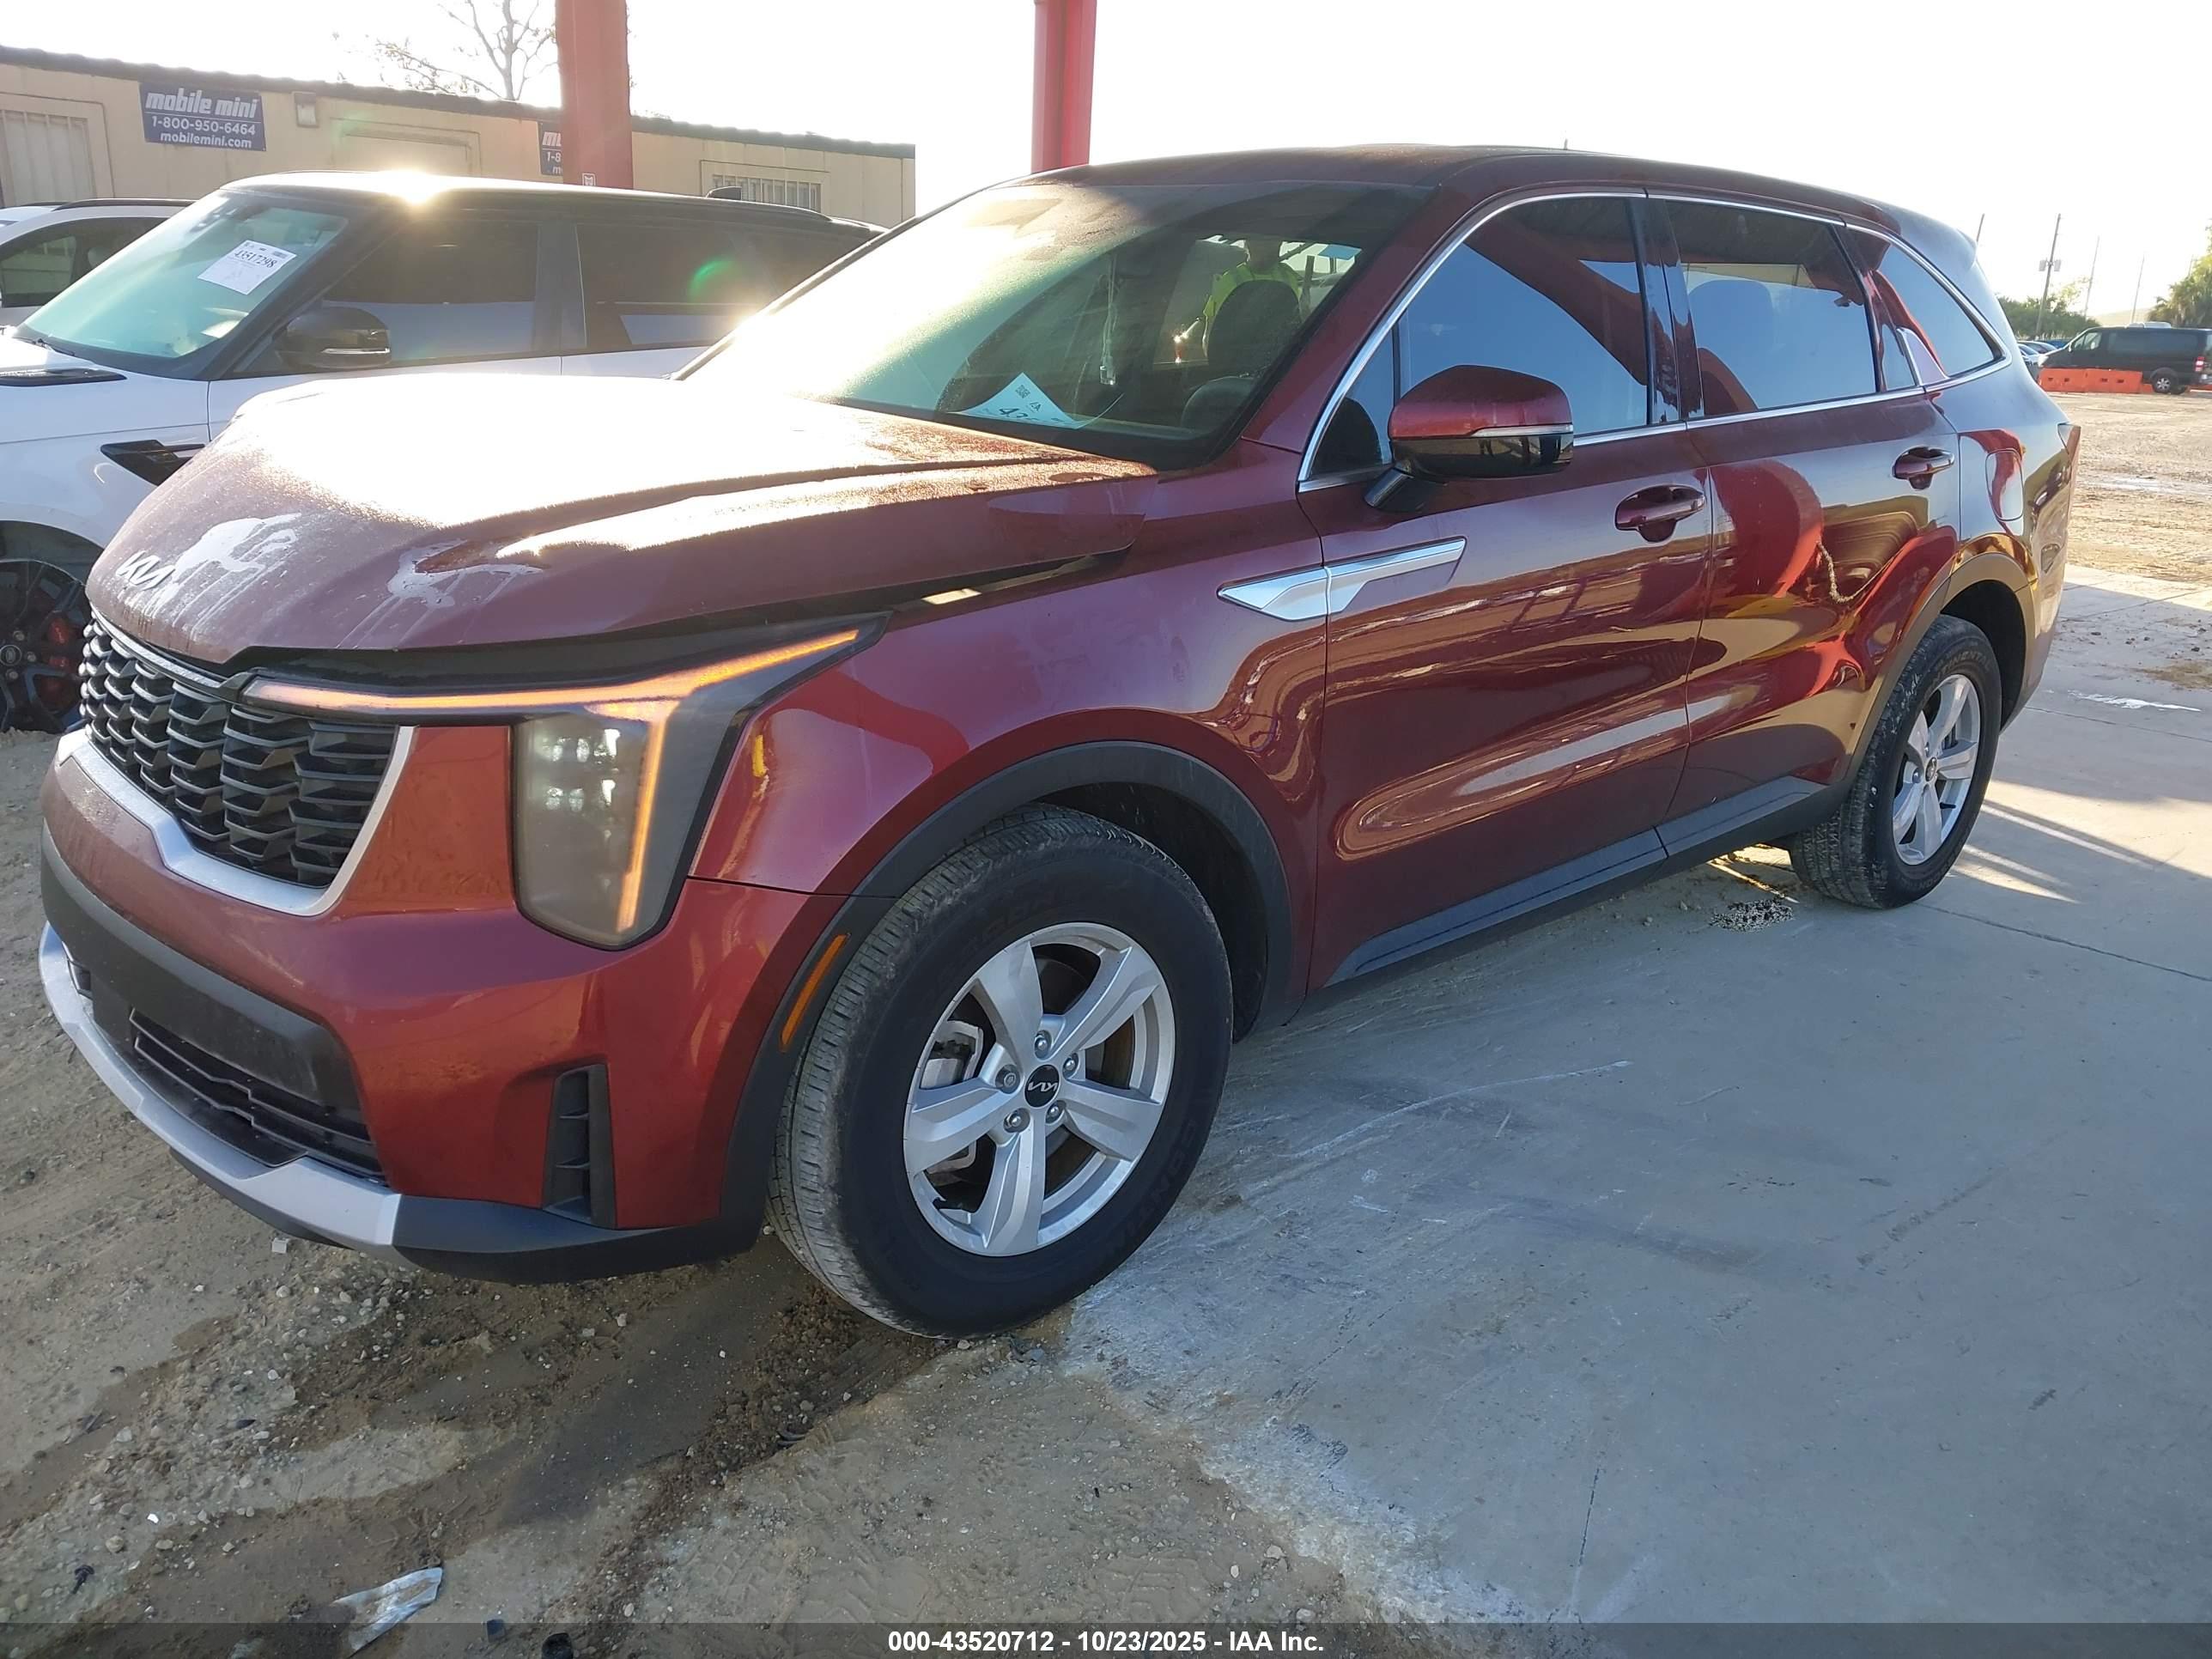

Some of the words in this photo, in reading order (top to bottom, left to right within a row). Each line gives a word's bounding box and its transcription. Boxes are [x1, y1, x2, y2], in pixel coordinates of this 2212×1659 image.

[145, 88, 212, 114] mobile
[215, 97, 258, 118] mini
[151, 115, 256, 136] 1-800-950-6464
[160, 131, 252, 149] mobilemini.com
